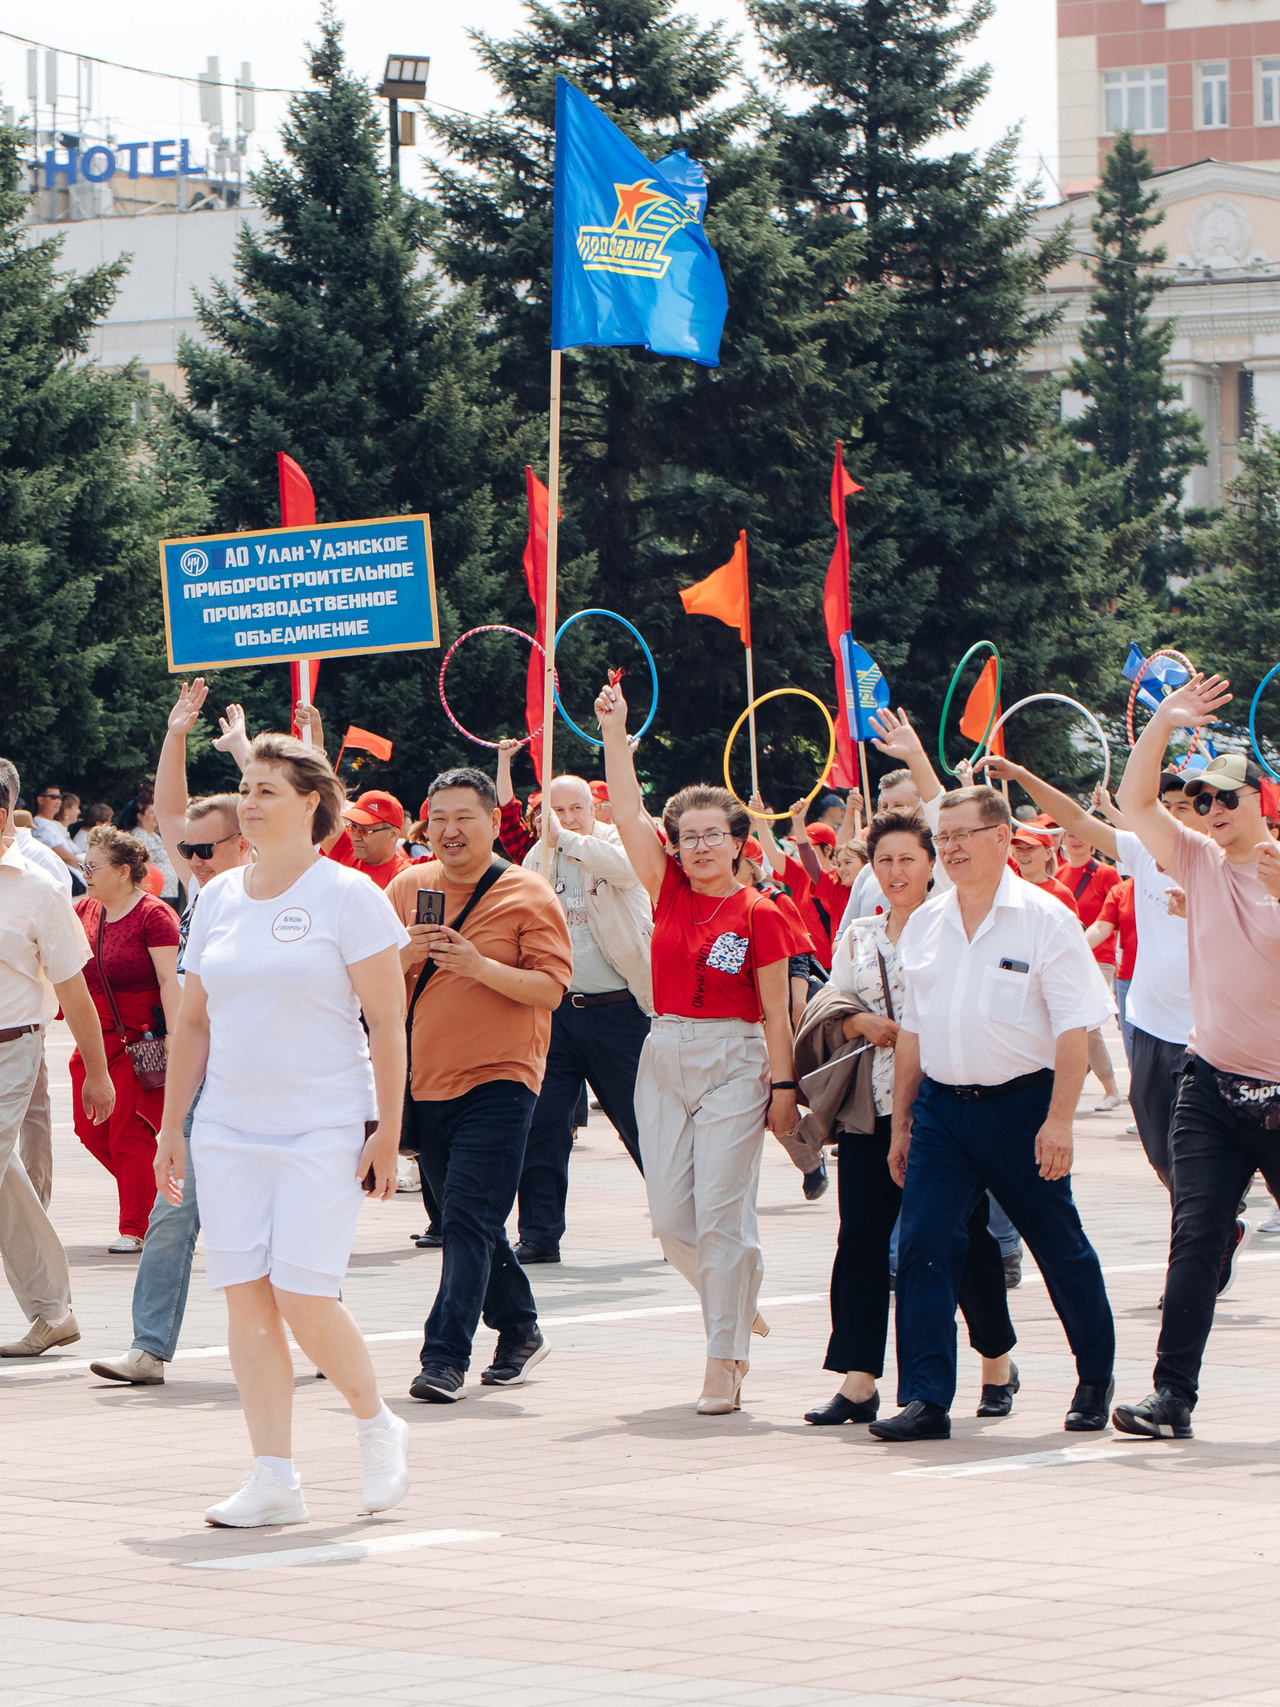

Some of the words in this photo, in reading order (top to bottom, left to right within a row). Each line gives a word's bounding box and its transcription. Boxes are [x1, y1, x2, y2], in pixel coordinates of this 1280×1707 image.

[45, 138, 205, 188] HOTEL
[225, 546, 249, 568] АО
[183, 562, 415, 599] ПРИБОРОСТРОИТЕЛЬНОЕ
[203, 590, 398, 624] ПРОИЗВОДСТВЕННОЕ
[234, 619, 370, 647] ОБЪЕДИНЕНИЕ
